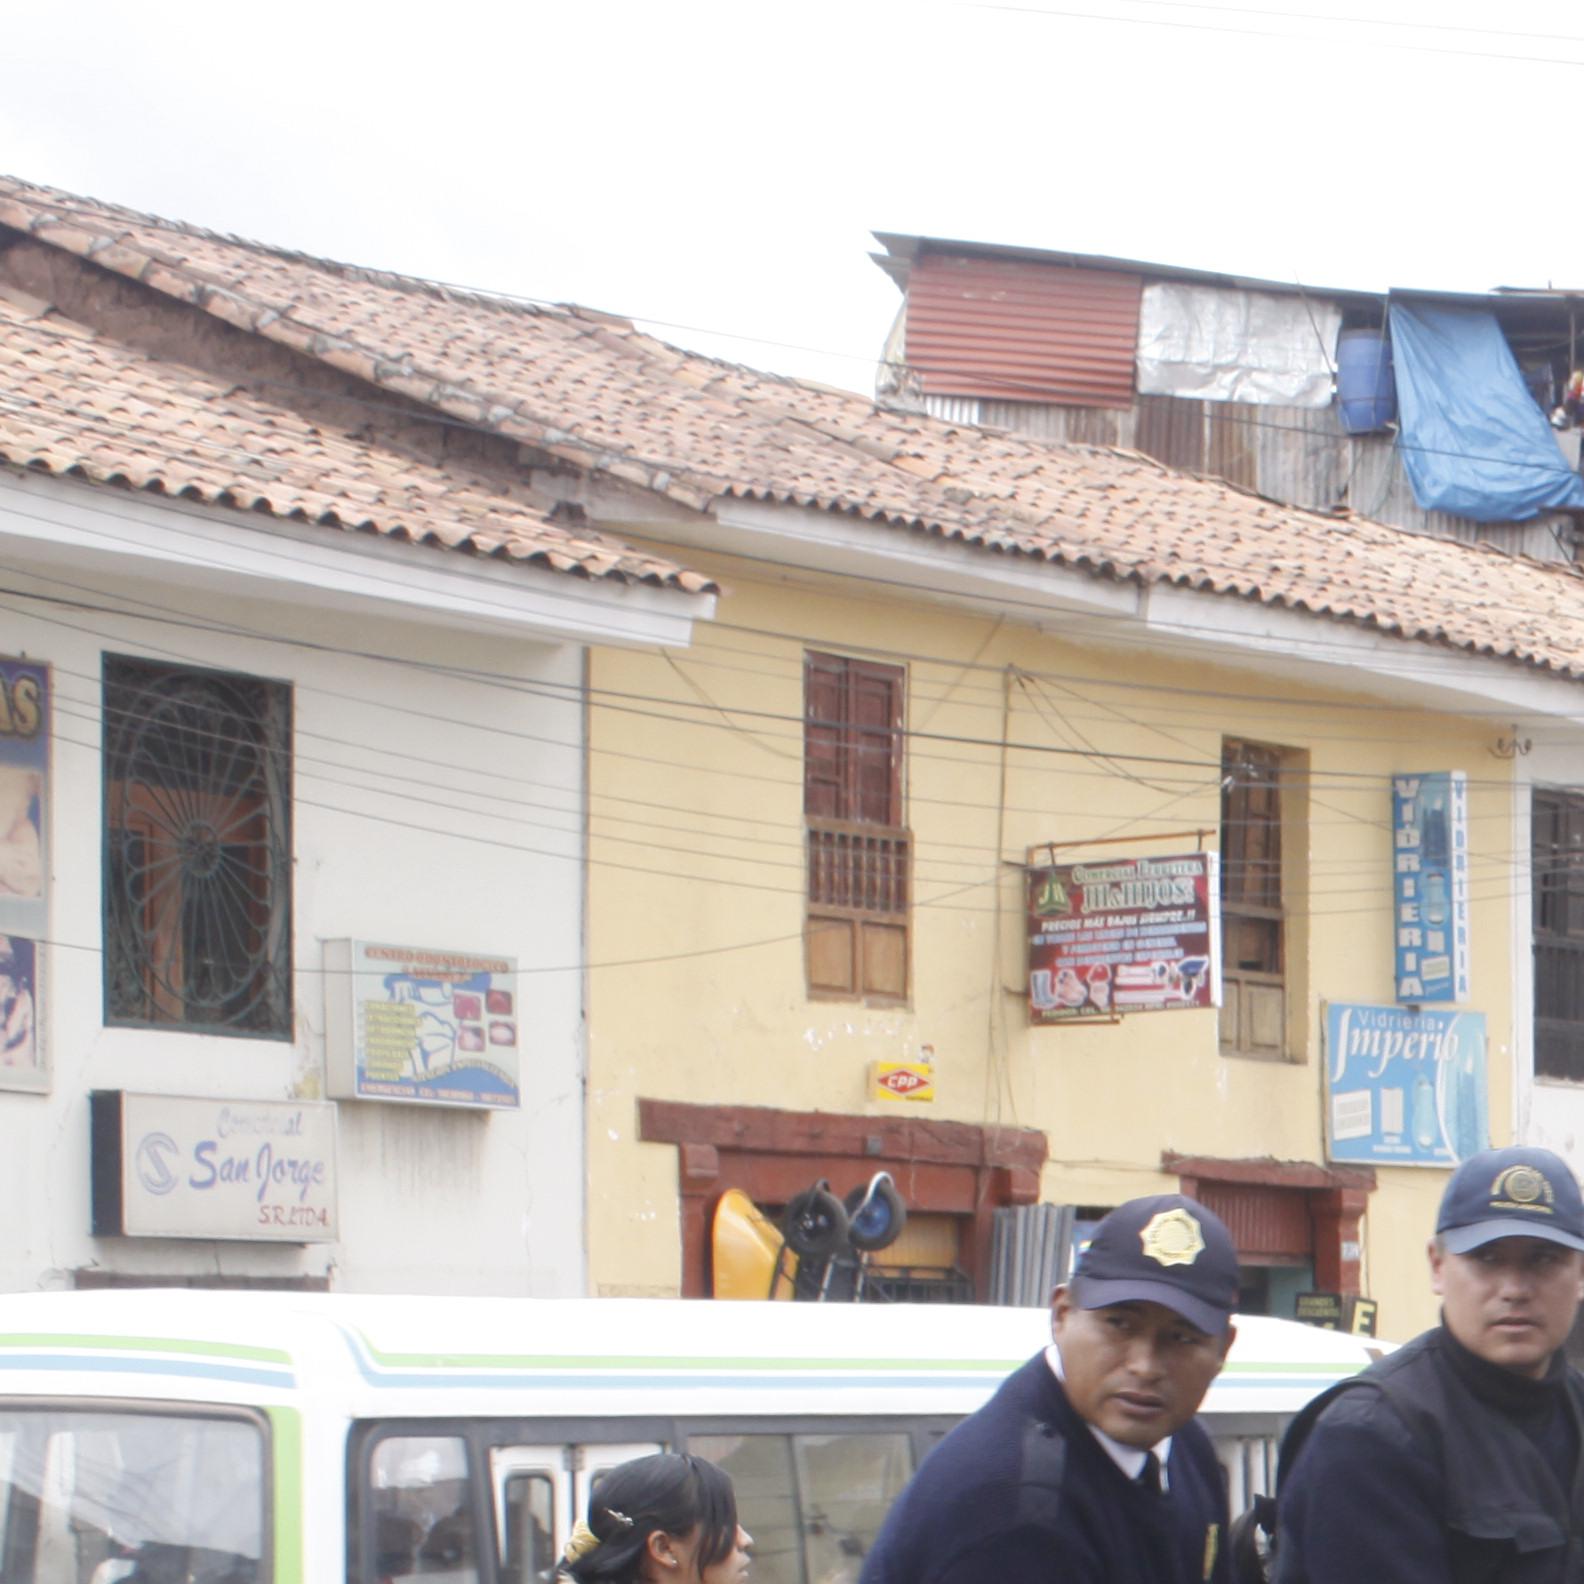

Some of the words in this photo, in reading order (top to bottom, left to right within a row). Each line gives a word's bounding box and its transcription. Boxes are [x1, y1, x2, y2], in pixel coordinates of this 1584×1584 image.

[1395, 779, 1424, 997] VIDRIERIA
[188, 1139, 250, 1190] San
[255, 1142, 325, 1203] Jorge
